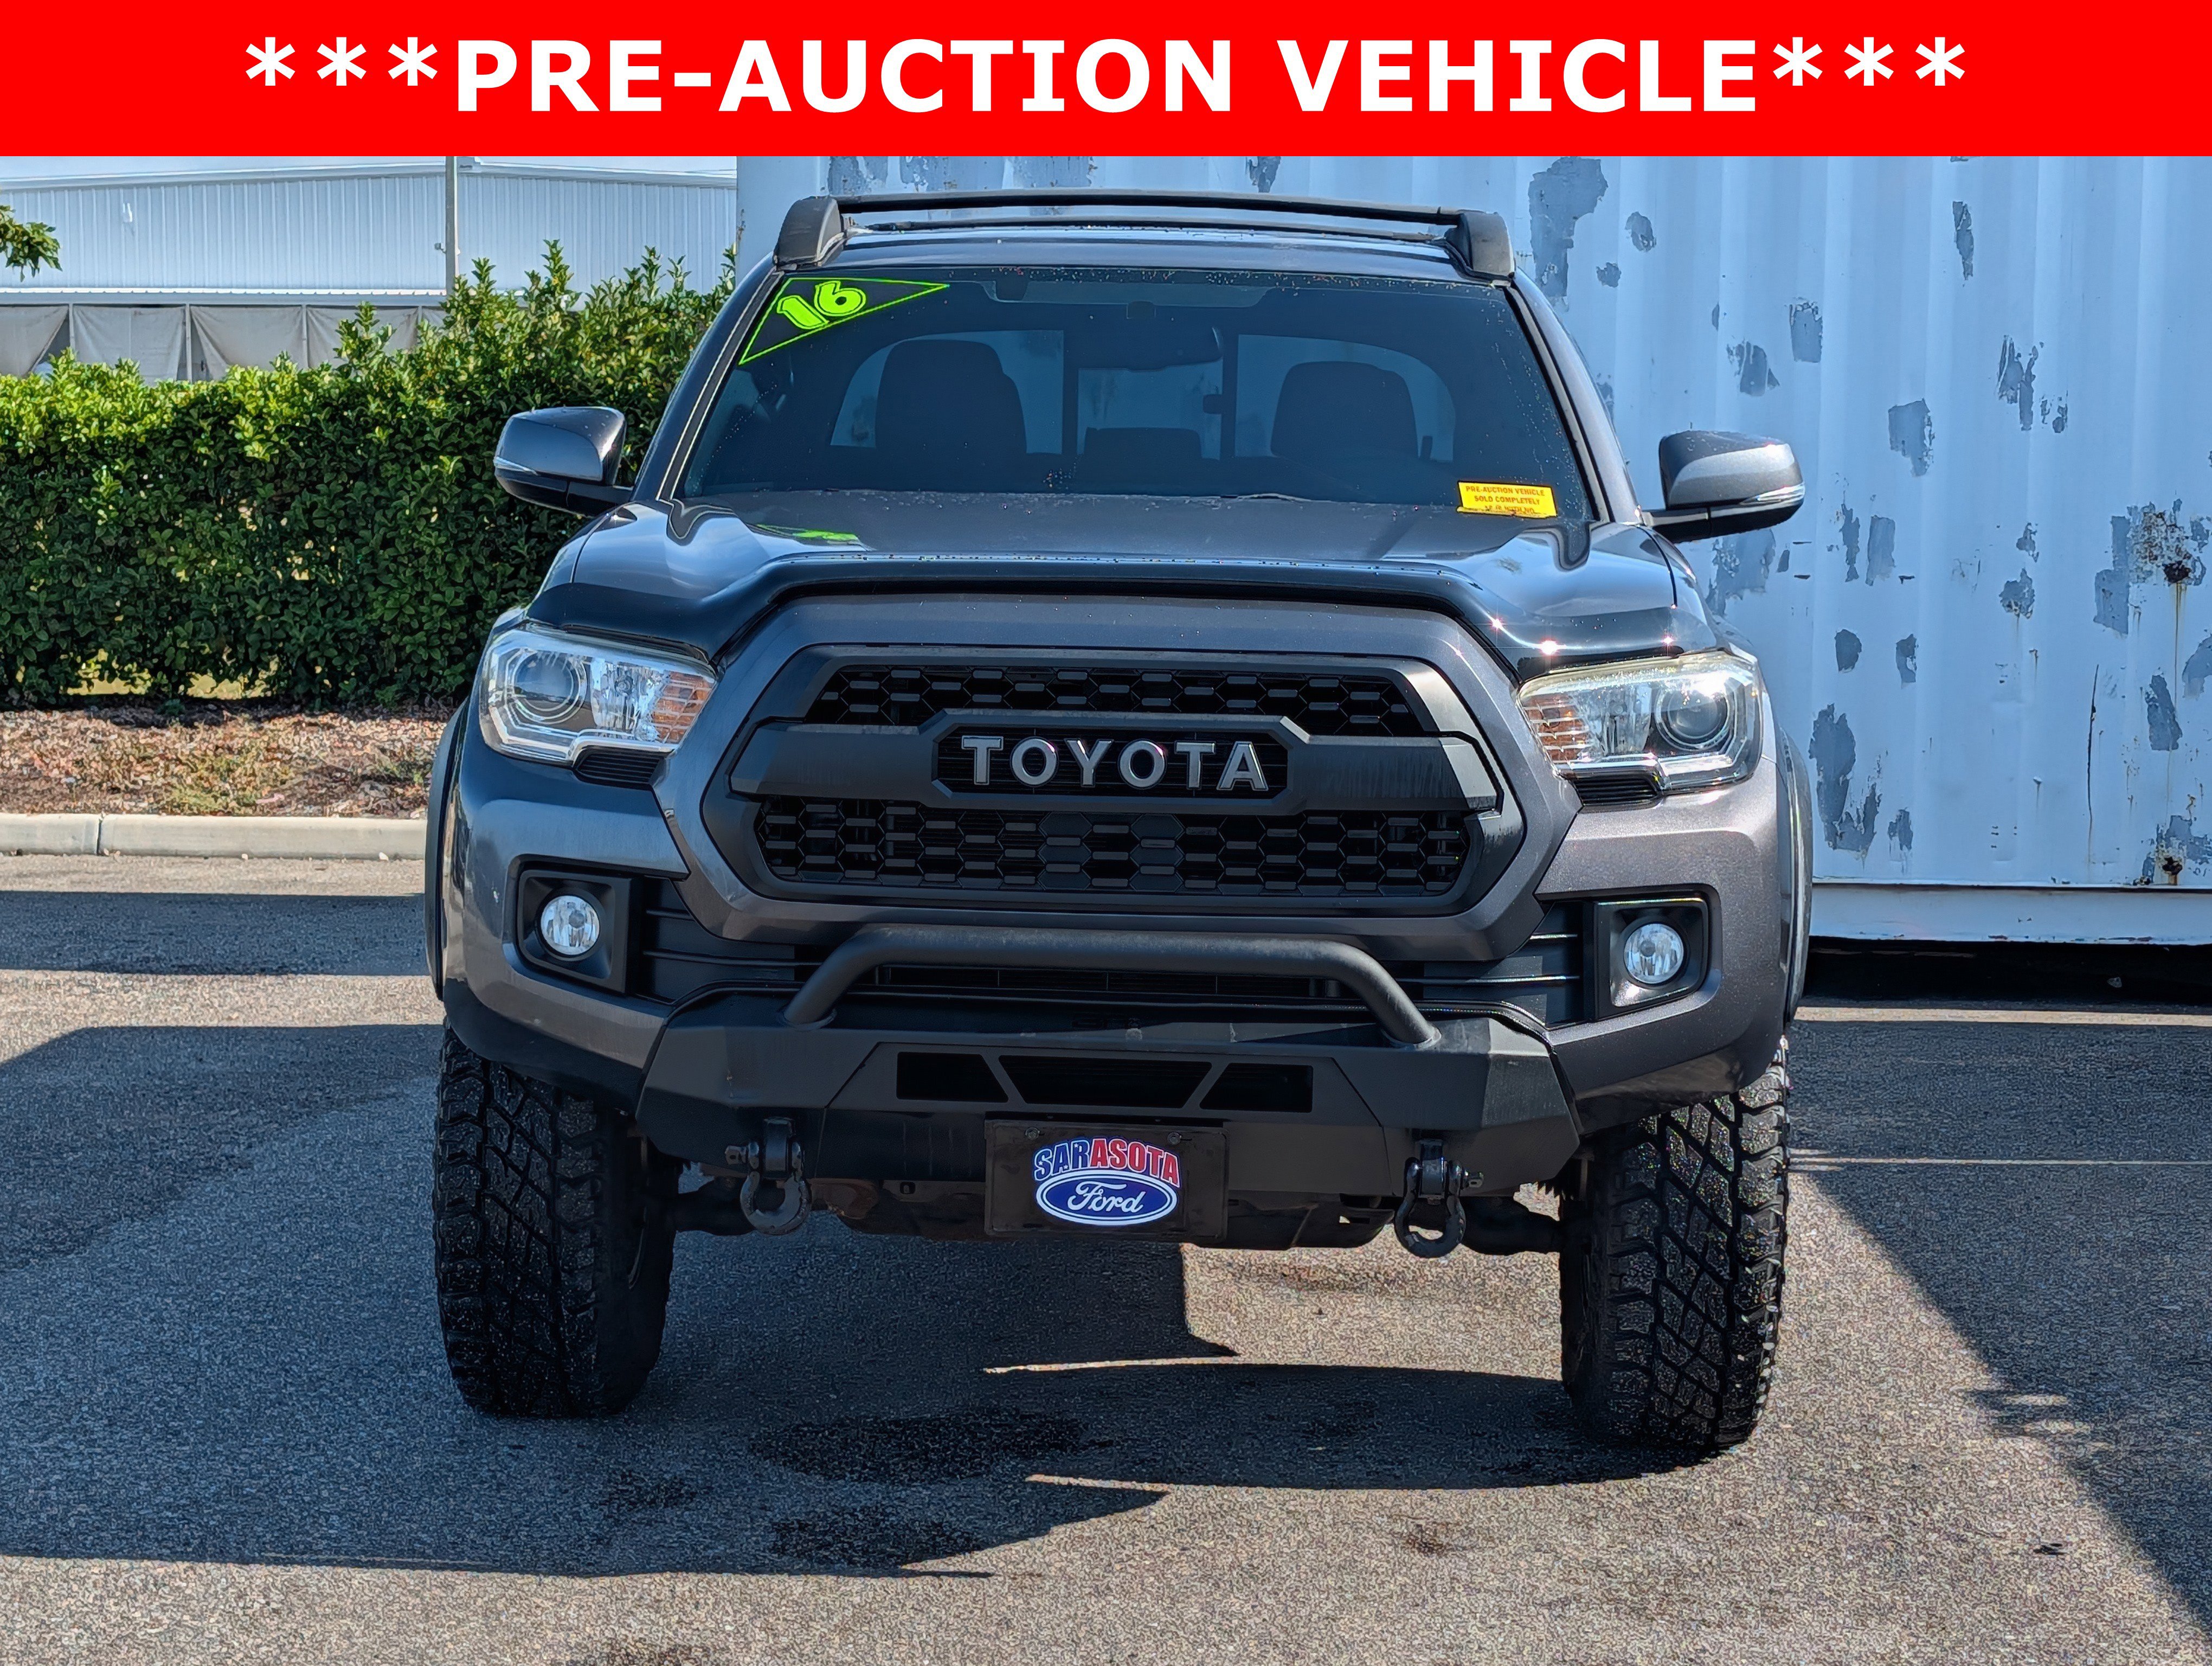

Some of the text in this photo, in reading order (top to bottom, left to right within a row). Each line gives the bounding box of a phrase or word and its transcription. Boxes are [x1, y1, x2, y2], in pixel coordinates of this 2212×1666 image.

[777, 280, 867, 330] 16
[1466, 486, 1513, 494] PRE-AUCTION
[1495, 497, 1540, 505] COMPLETELY
[961, 735, 1269, 791] TOYOTA
[1034, 1138, 1180, 1188] SARASOTA
[1068, 1181, 1146, 1213] Ford
